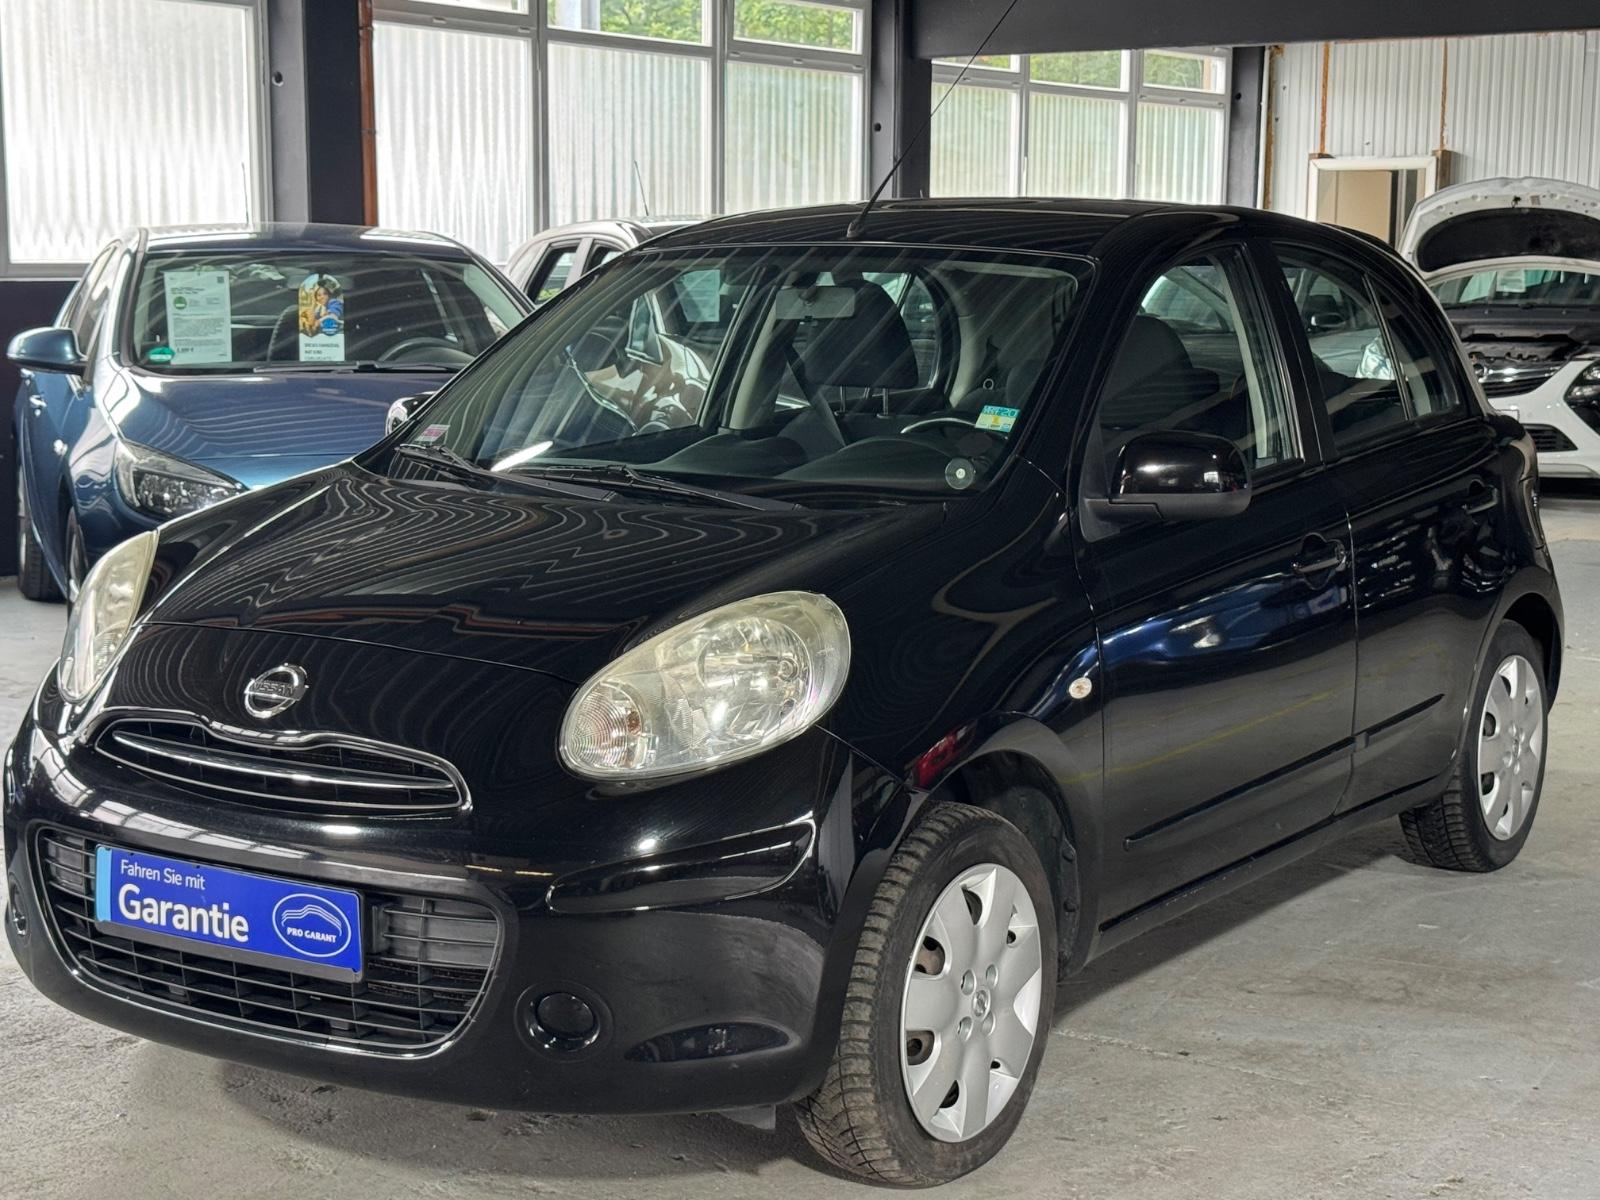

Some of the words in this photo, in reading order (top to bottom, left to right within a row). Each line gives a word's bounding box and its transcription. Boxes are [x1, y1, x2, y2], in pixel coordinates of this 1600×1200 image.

[121, 859, 160, 881] Fahren
[163, 868, 182, 886] Sie
[185, 874, 206, 890] mit
[118, 883, 249, 942] Garantie
[286, 927, 304, 937] PRO
[304, 930, 337, 943] GARANT
